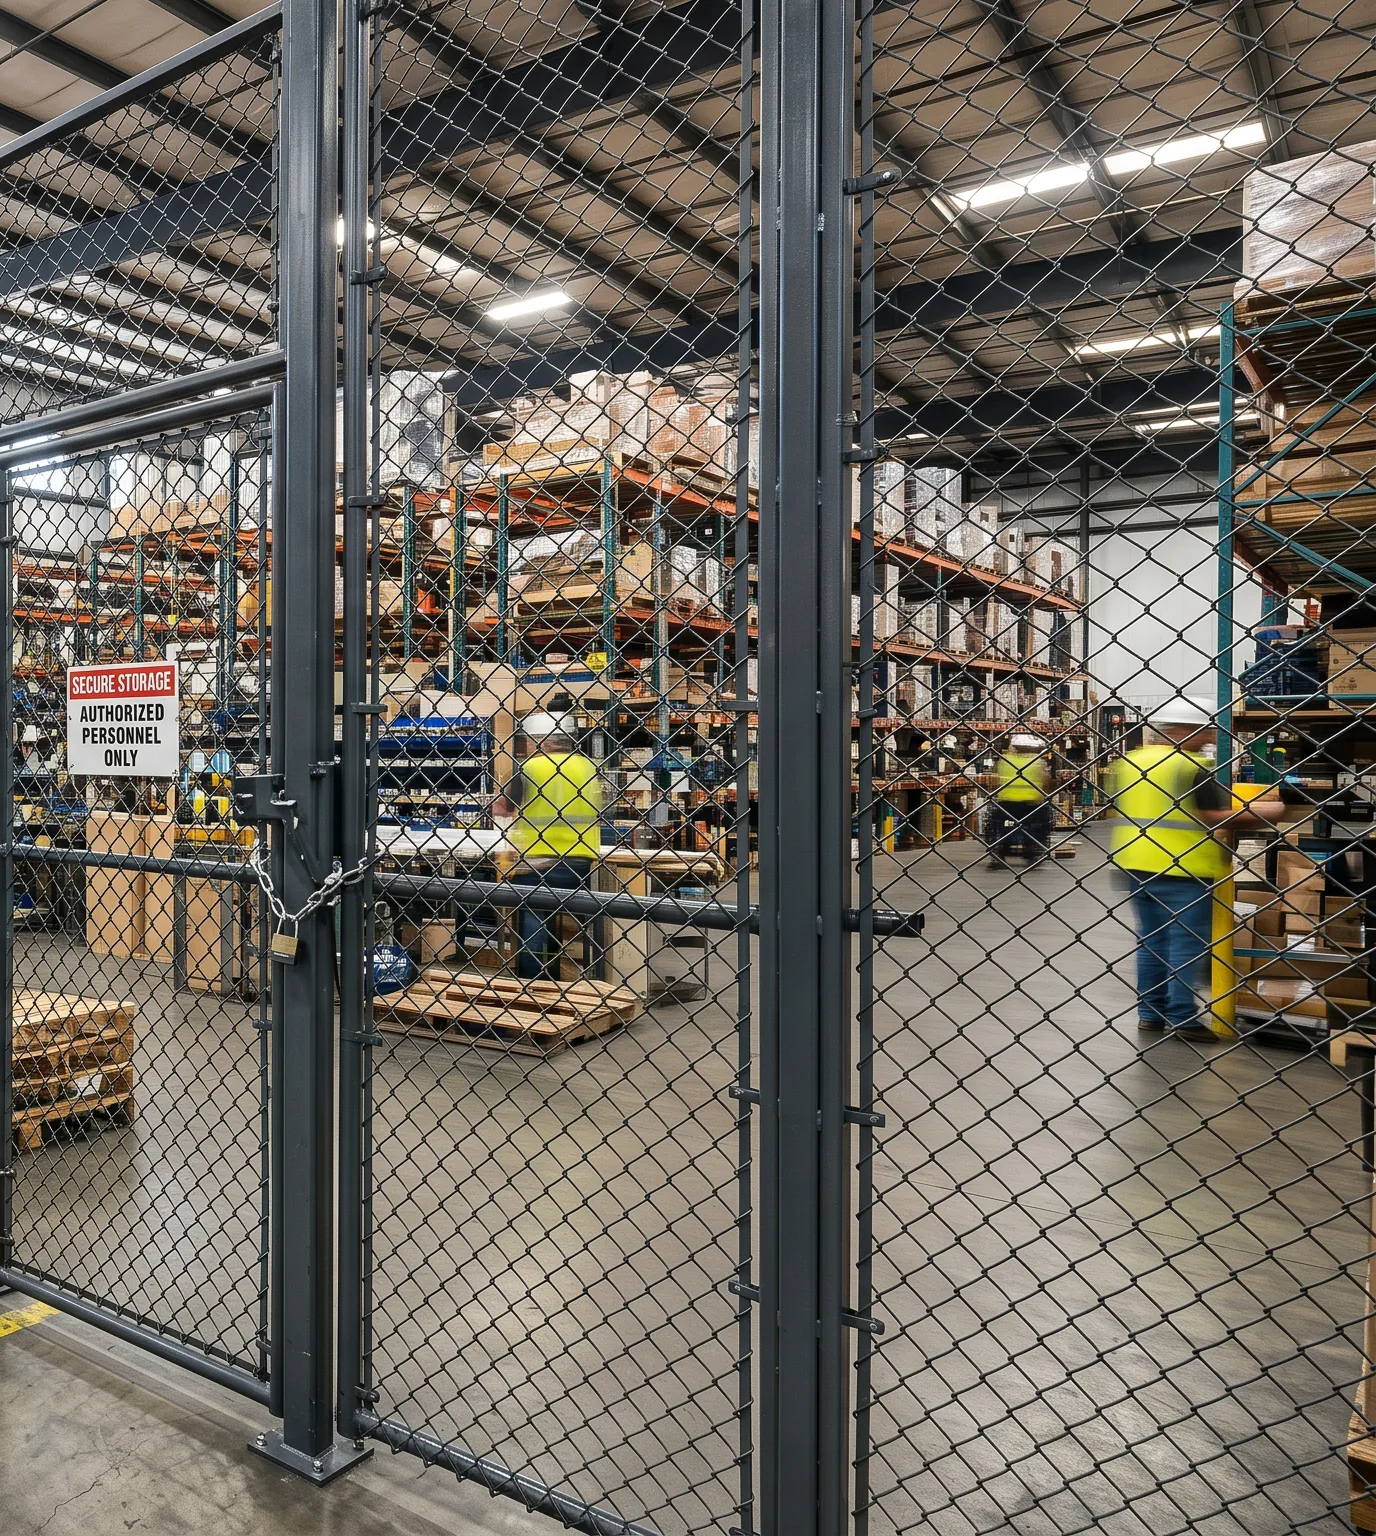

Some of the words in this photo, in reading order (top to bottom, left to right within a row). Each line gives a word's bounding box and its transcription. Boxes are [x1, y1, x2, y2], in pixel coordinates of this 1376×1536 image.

[72, 674, 115, 695] SECURE
[118, 671, 171, 693] STORAGE
[80, 703, 164, 722] AUTHORIZED
[82, 727, 161, 744] PERSONNEL
[104, 749, 138, 766] ONLY
